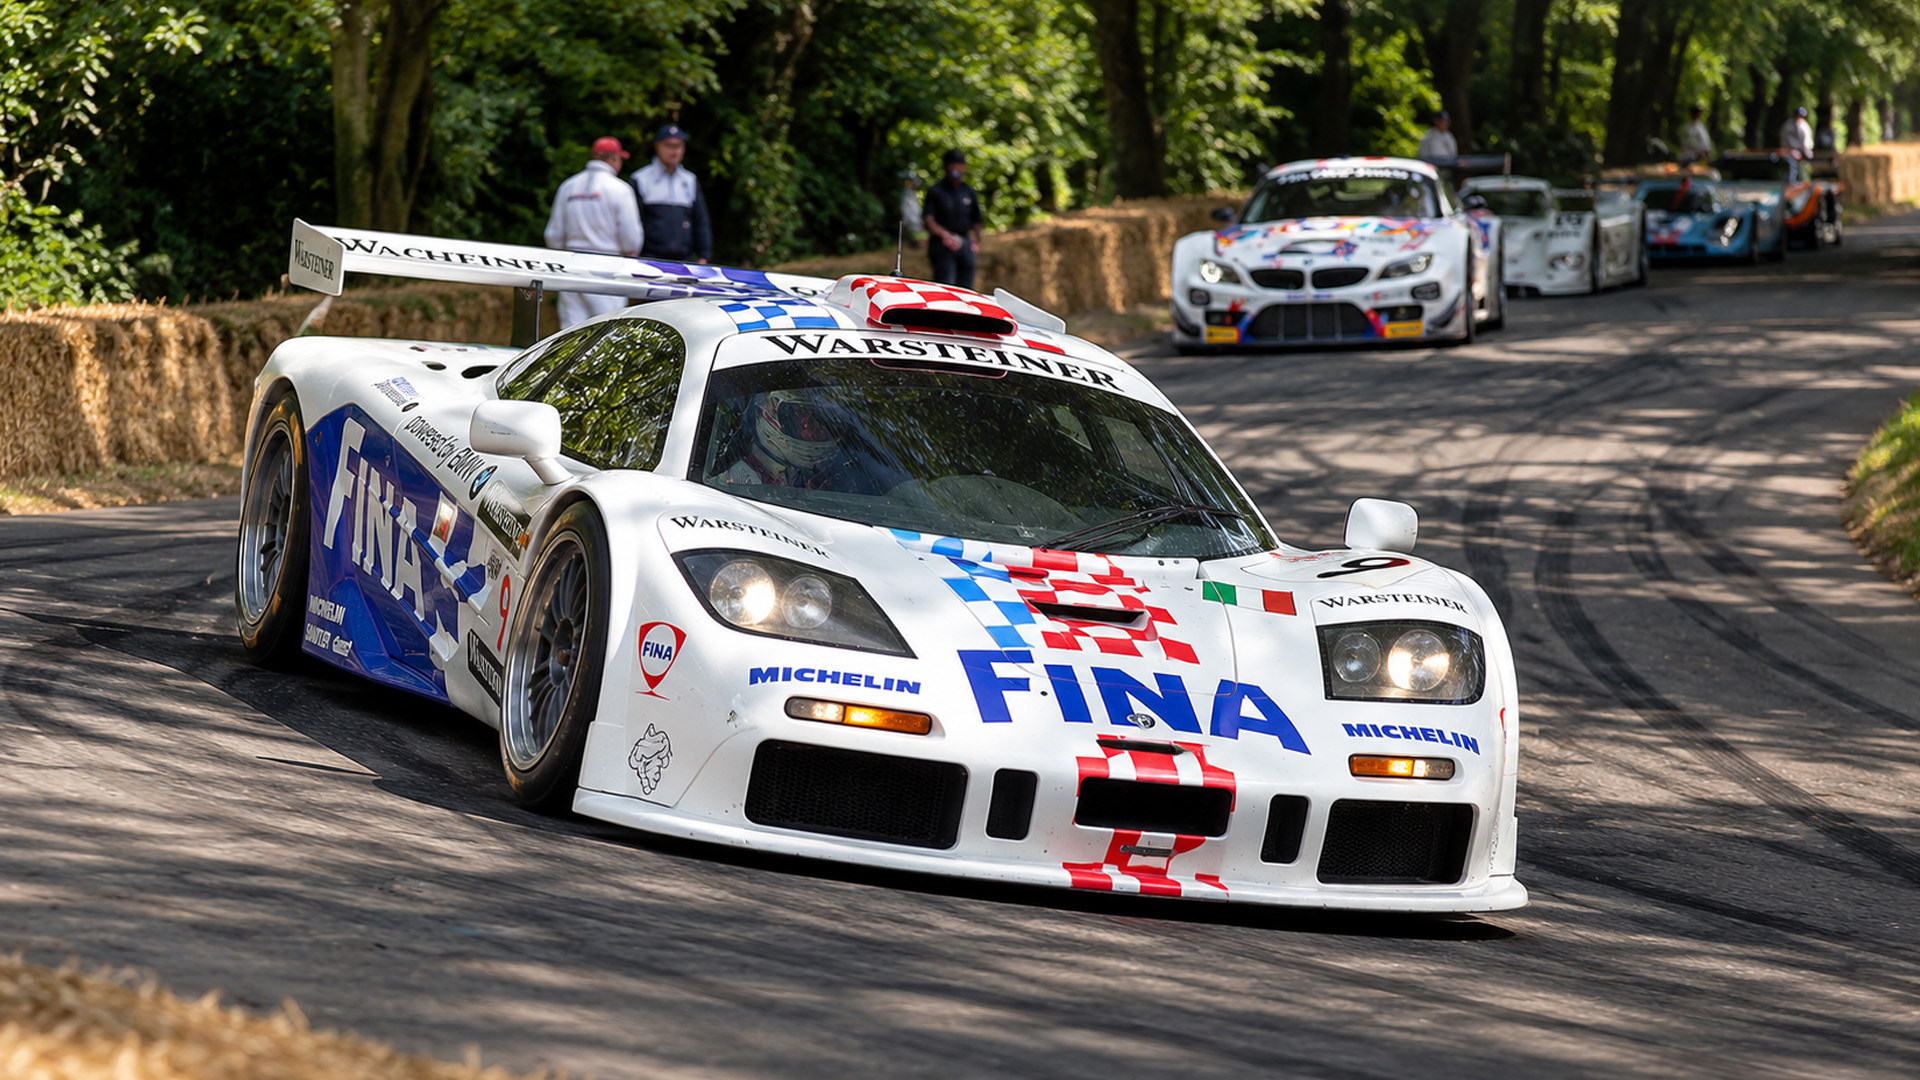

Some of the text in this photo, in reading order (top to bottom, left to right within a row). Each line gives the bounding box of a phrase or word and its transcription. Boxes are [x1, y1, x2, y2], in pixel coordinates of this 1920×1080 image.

[761, 333, 1125, 391] WARSTEINER
[323, 416, 425, 622] FINA
[671, 515, 831, 559] WARSTEINER
[1316, 557, 1411, 579] 9
[497, 574, 511, 652] 9
[1318, 593, 1468, 615] WARSTEINER
[642, 641, 673, 662] FINA
[749, 666, 921, 695] MICHELIN
[956, 649, 1312, 756] FINA
[1341, 723, 1481, 755] MICHELIN
